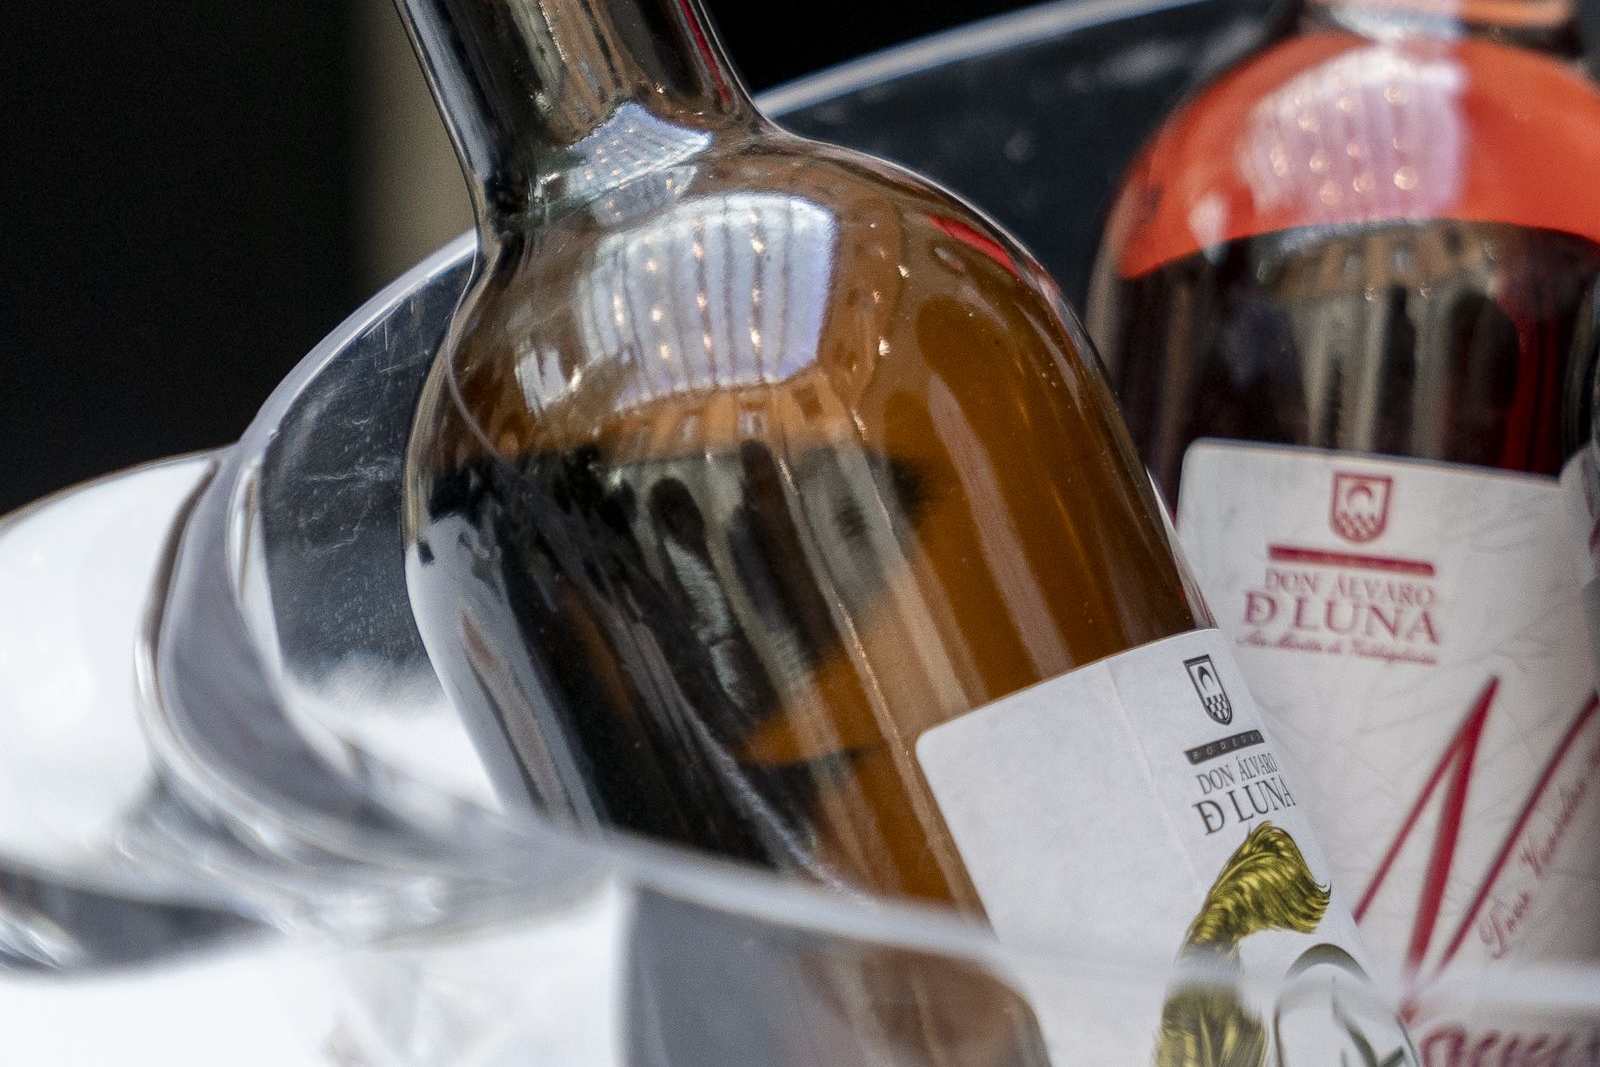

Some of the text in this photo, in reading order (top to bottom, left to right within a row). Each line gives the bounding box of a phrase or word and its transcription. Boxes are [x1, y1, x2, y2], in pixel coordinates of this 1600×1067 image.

[1265, 567, 1320, 594] DON
[1290, 593, 1441, 645] LUNA
[1195, 764, 1236, 796] DON
[1226, 774, 1297, 823] LUNA
